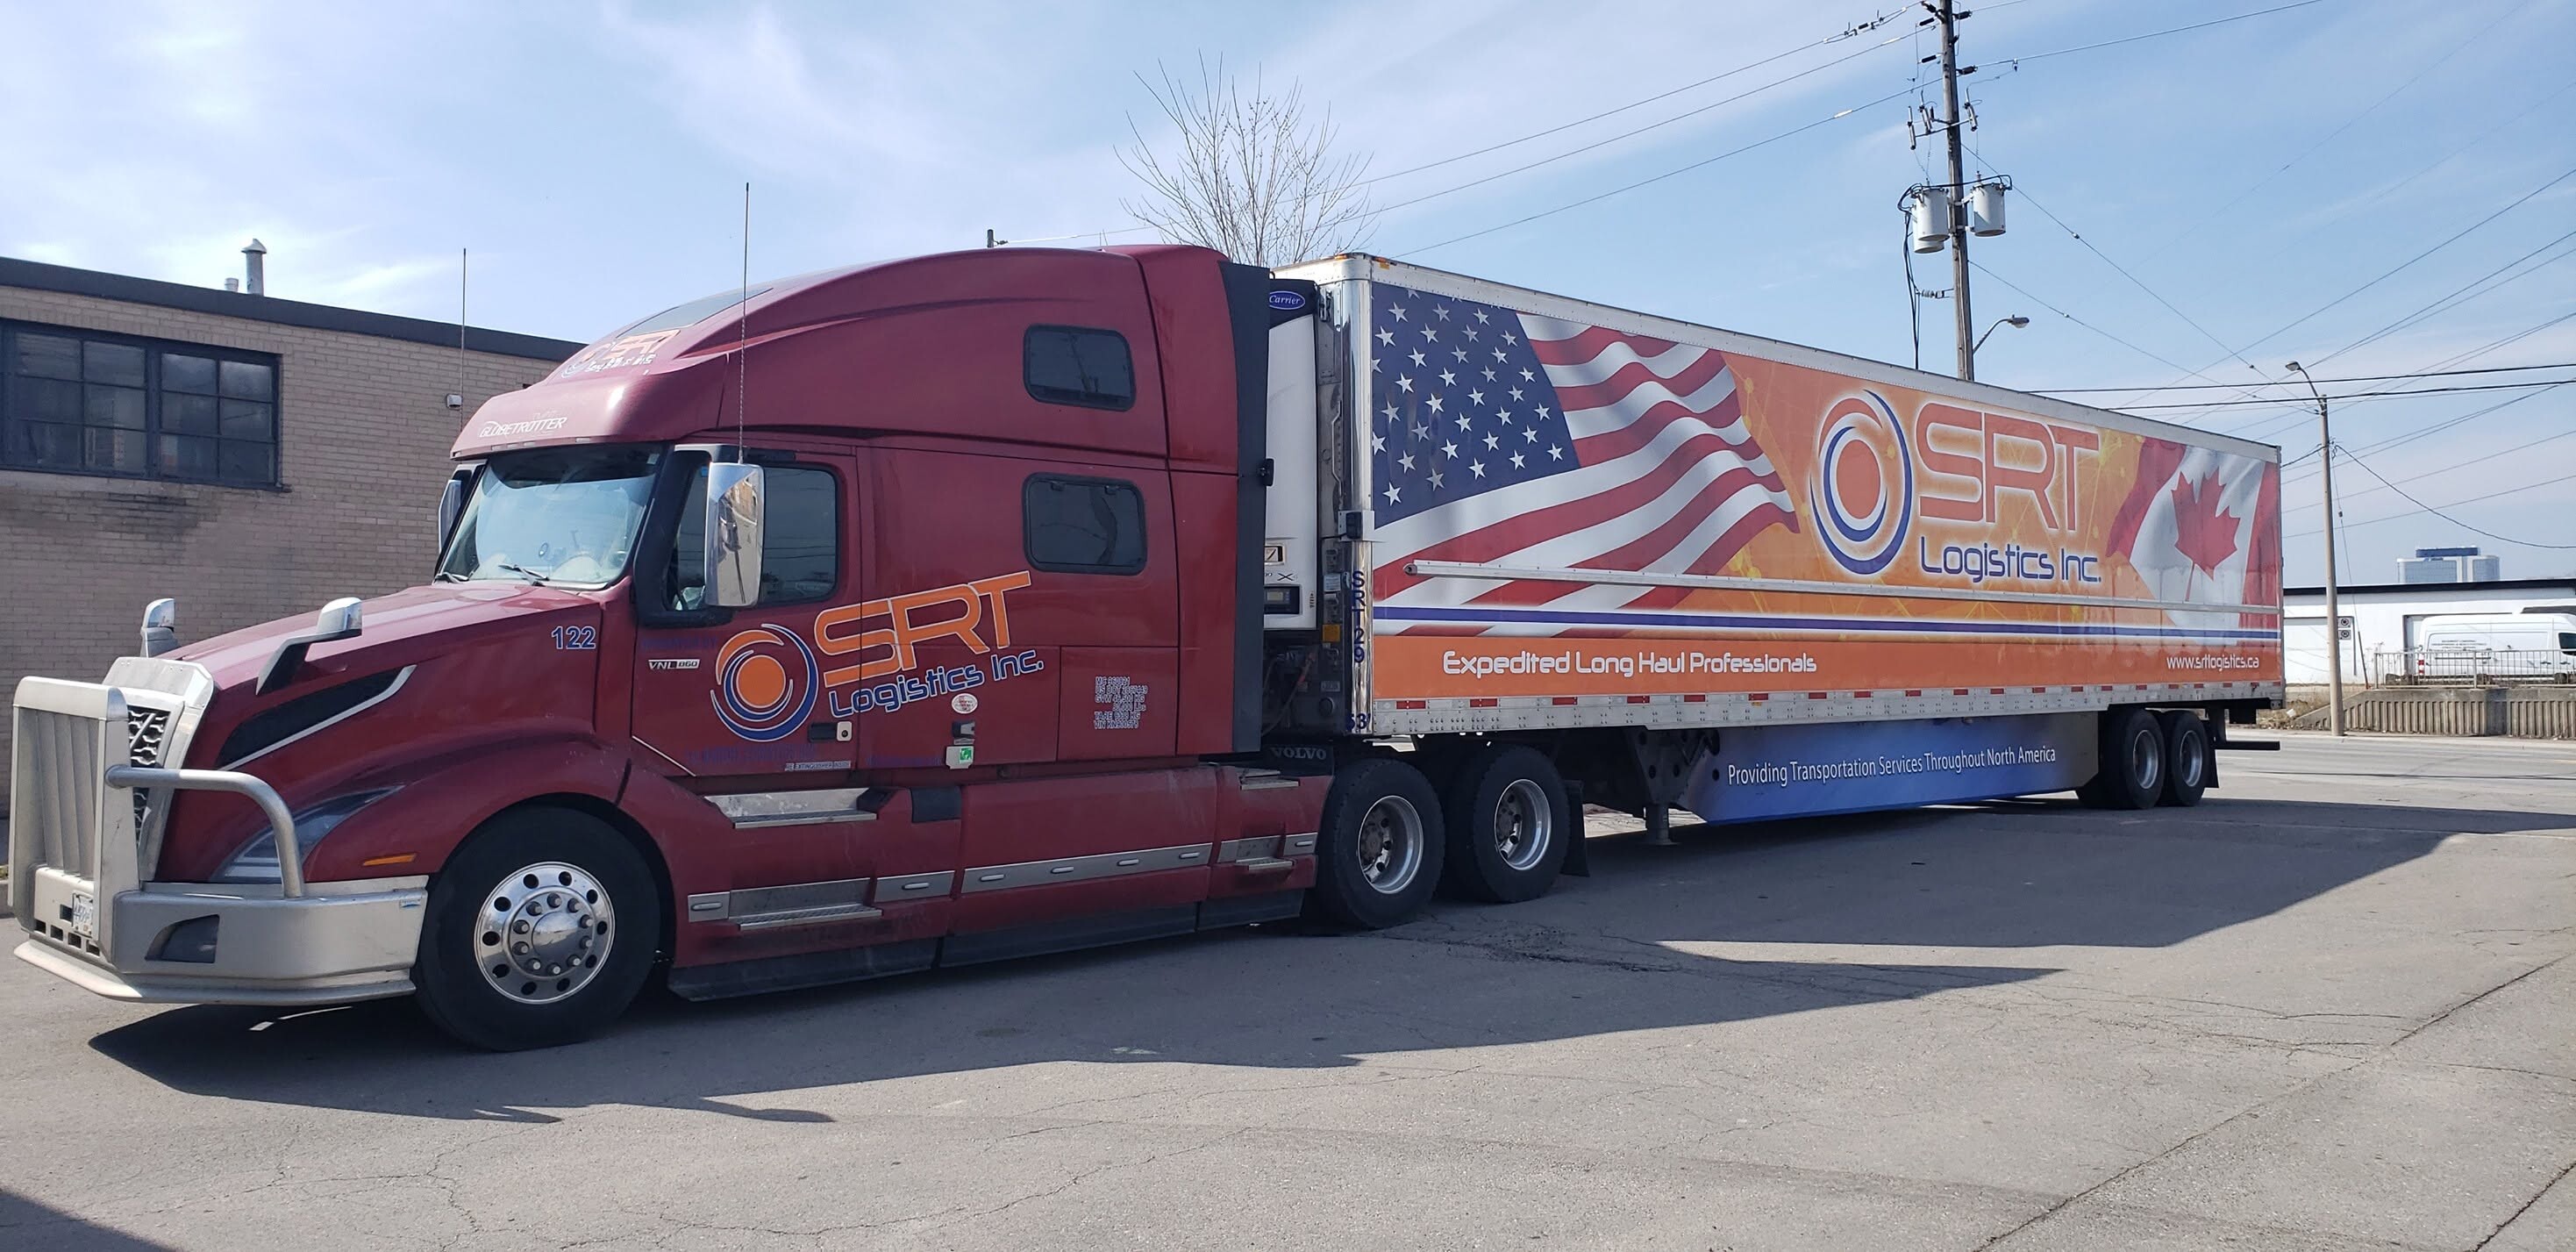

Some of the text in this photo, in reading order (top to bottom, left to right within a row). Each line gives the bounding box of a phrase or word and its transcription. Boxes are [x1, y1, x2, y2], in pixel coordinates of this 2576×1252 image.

[1269, 295, 1301, 304] Carrier
[480, 417, 567, 437] GLOBETROTTER
[1916, 403, 2099, 531] SRT
[1921, 536, 2101, 583] Logistics Inc.
[551, 626, 596, 649] 122
[814, 570, 1031, 688] SRT
[648, 659, 676, 670] VNL
[1443, 650, 1817, 678] Expedited Long Haul Professionals
[2166, 654, 2260, 672] www.srtlogistics.ca
[829, 664, 984, 718] Logistics
[991, 650, 1044, 681] Inc.
[1271, 747, 1326, 760] VOLVO
[1728, 746, 2056, 787] Providing Transportation Services Throughout North America
